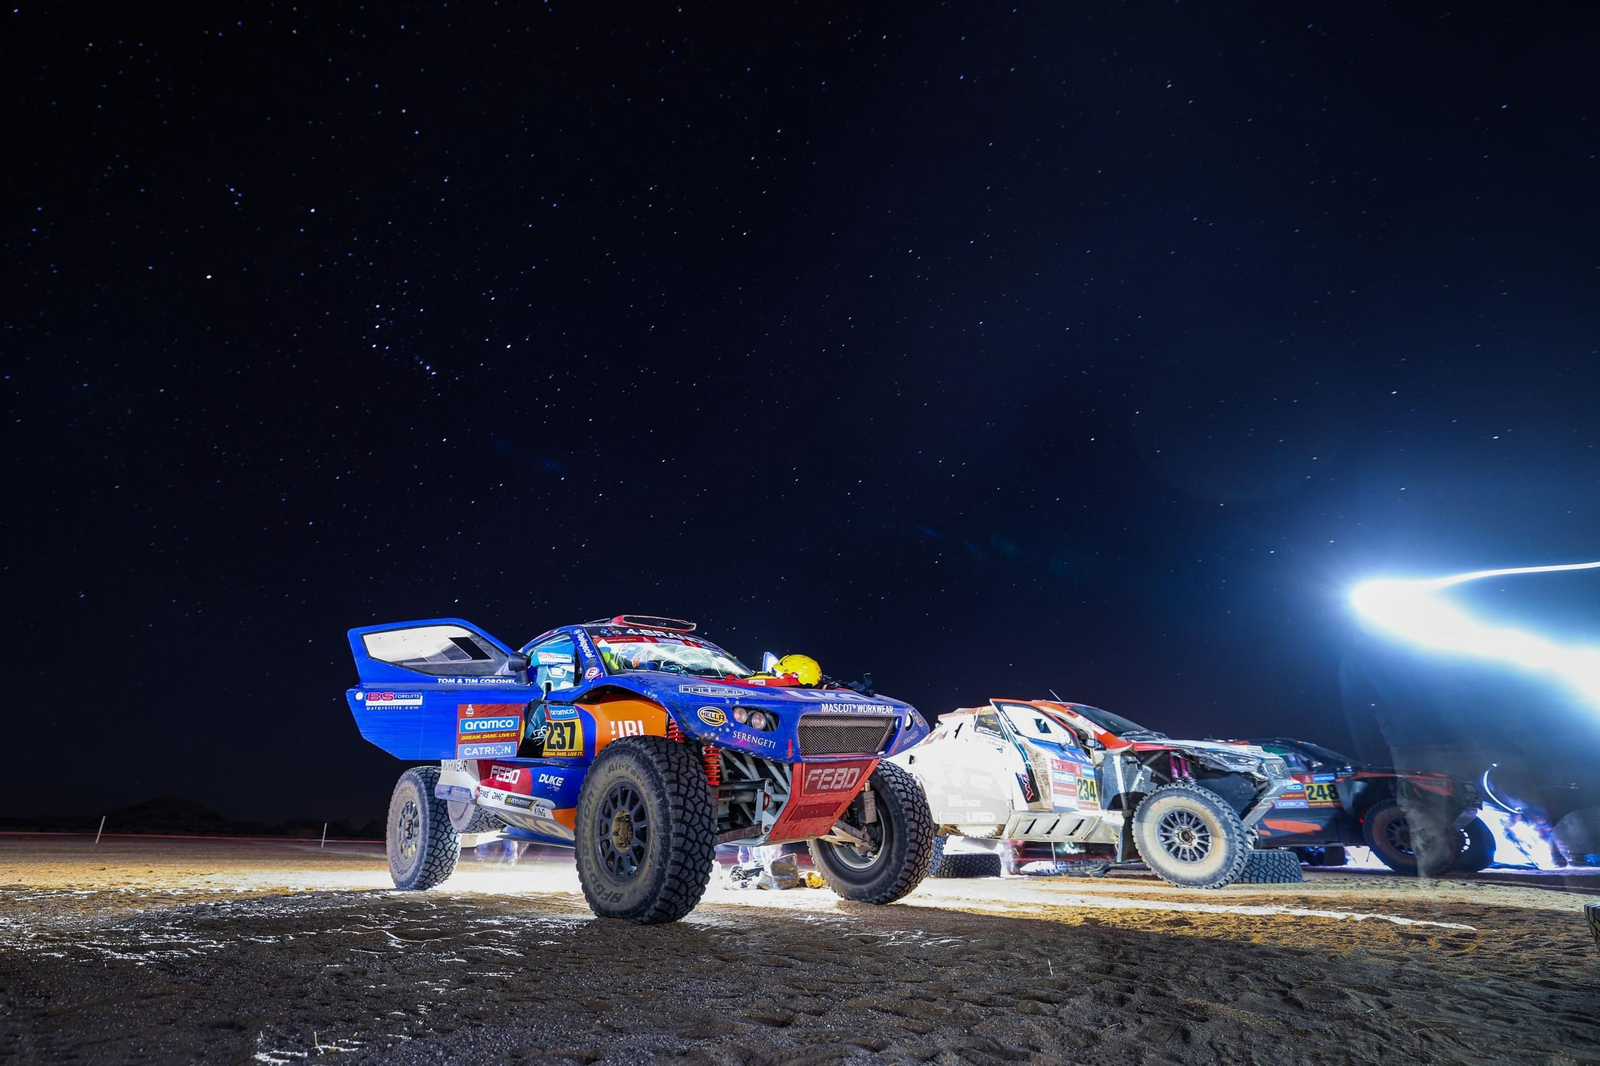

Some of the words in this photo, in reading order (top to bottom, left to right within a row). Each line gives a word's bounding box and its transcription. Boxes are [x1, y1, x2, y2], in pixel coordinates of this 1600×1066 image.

[368, 692, 394, 701] BS
[701, 710, 725, 722] HELLA
[857, 704, 894, 714] WORKWEAR
[464, 719, 514, 730] aramco
[546, 721, 576, 750] 237
[732, 730, 776, 749] SERENGETI
[538, 773, 564, 786] DUKE
[805, 767, 860, 790] FEBO
[1077, 778, 1097, 802] 234
[1306, 783, 1339, 800] 248
